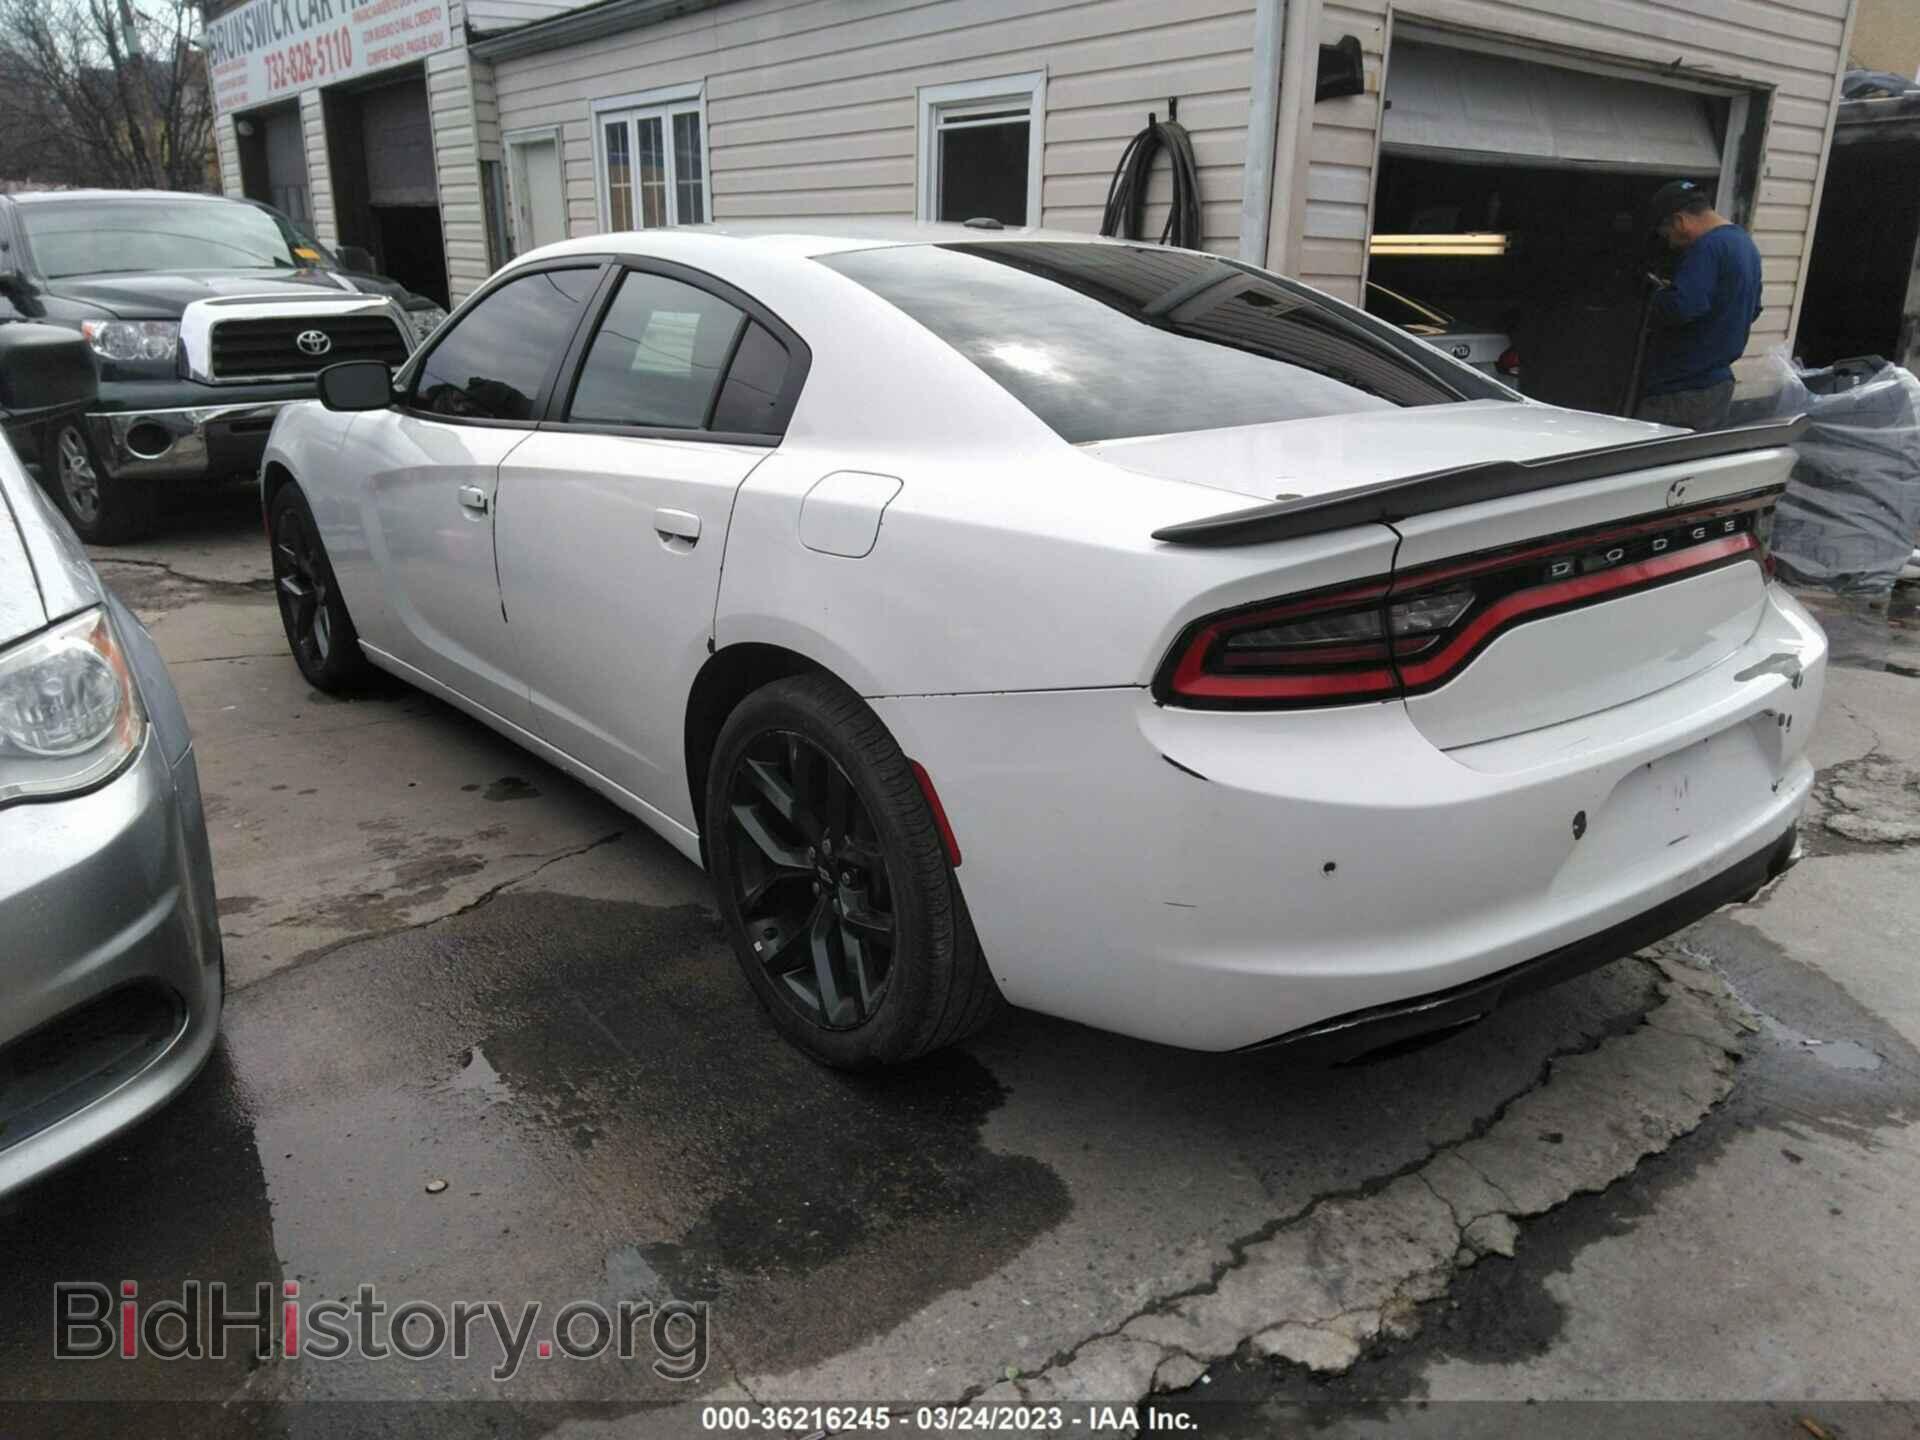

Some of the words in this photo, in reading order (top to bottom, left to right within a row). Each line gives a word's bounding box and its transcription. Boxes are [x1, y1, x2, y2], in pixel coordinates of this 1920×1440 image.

[207, 0, 295, 67] BRUNSWICK
[264, 25, 353, 92] 732-828-5110
[1552, 520, 1735, 576] DODGE
